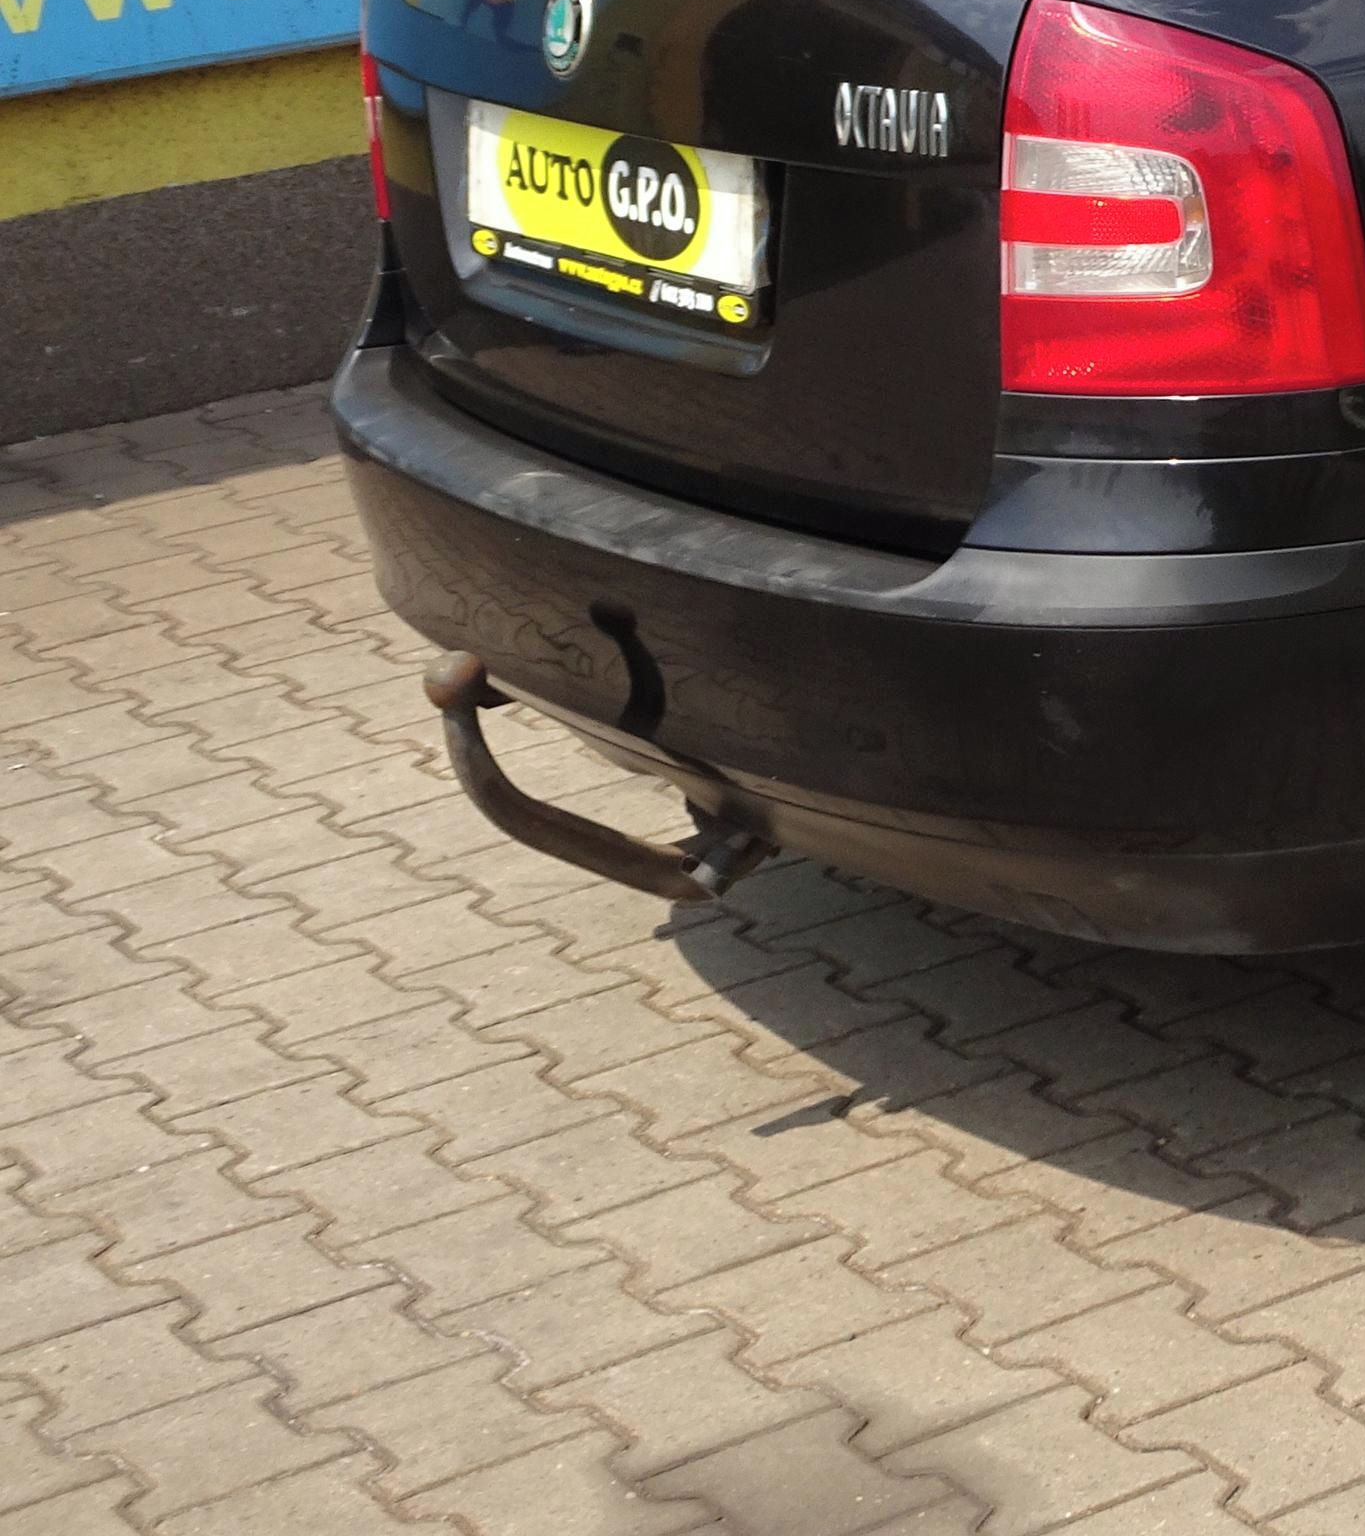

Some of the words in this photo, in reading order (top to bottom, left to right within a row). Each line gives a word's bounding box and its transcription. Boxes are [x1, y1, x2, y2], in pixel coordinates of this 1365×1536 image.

[835, 82, 948, 157] OCTAVIA
[506, 141, 595, 207] AUTO
[608, 160, 695, 234] G.P.O.
